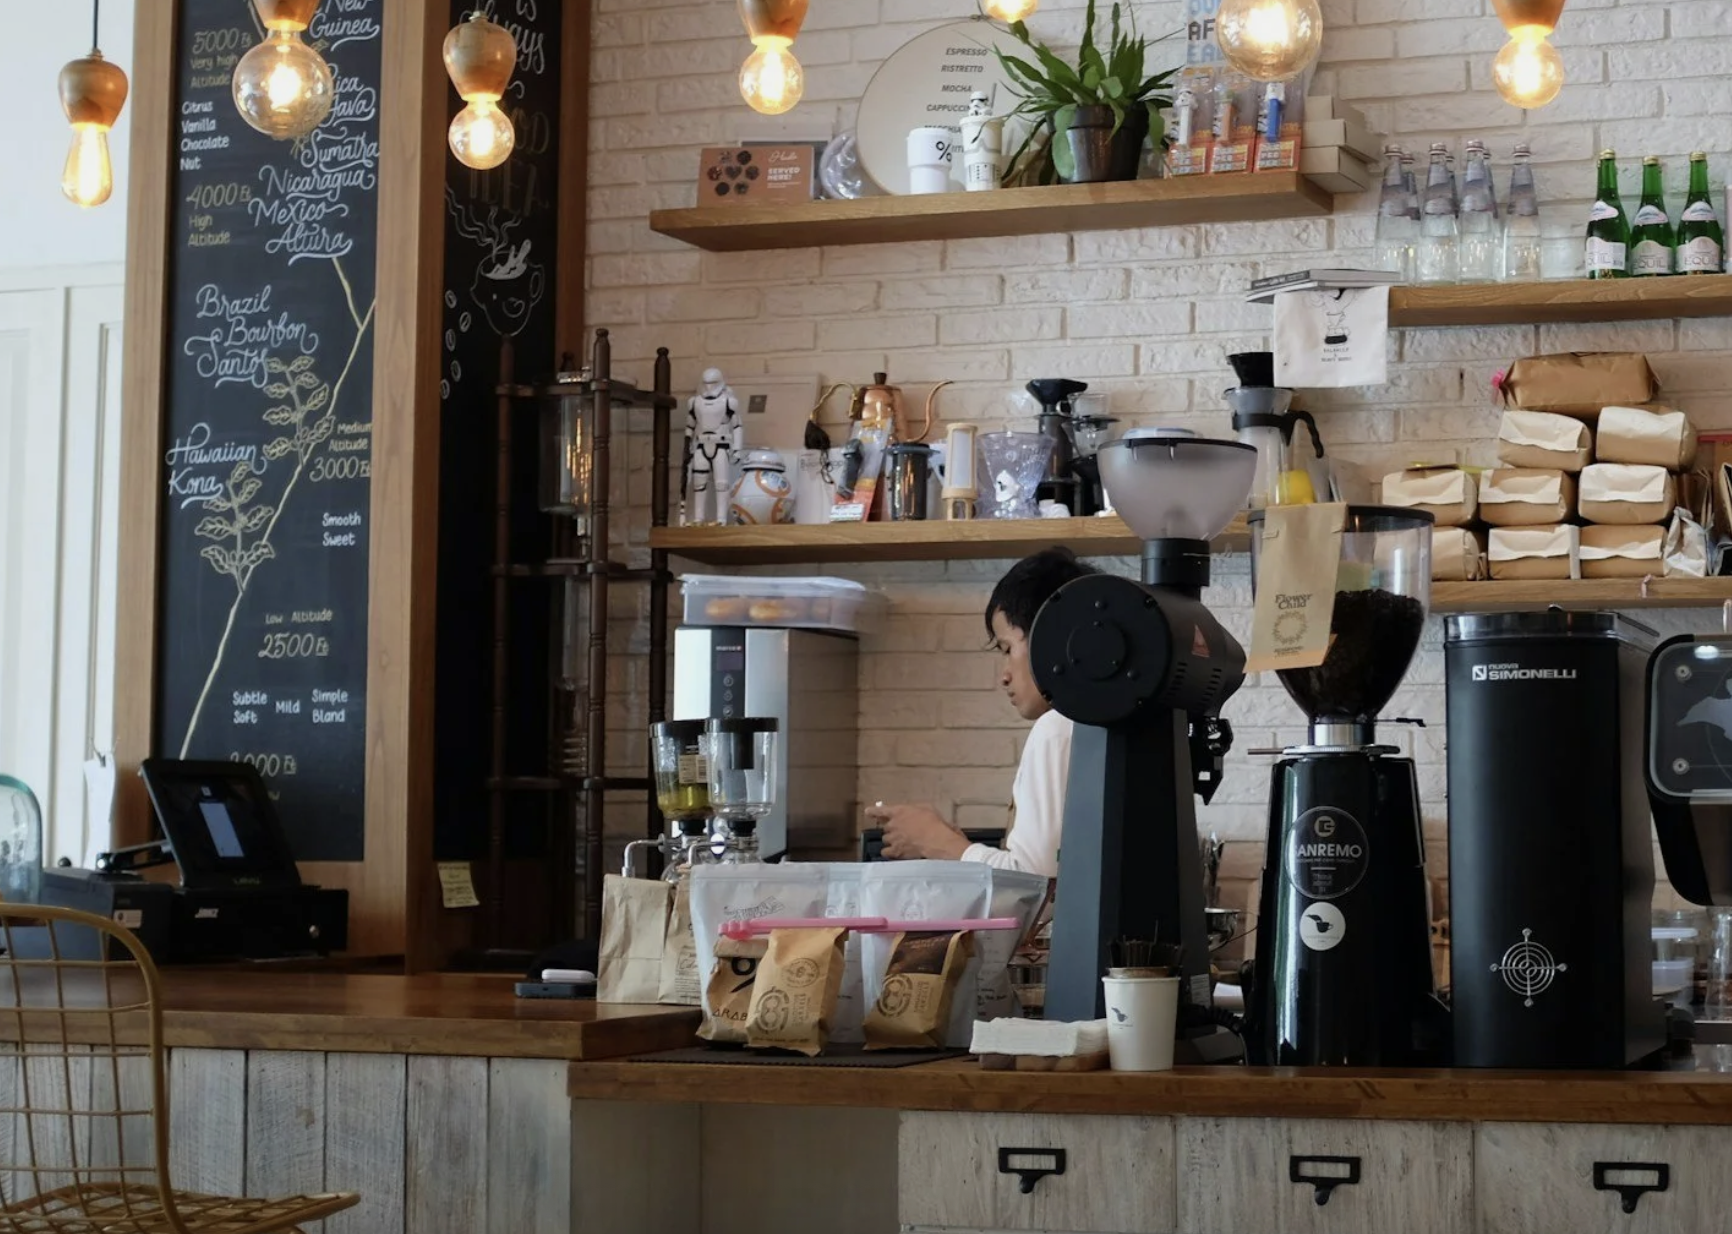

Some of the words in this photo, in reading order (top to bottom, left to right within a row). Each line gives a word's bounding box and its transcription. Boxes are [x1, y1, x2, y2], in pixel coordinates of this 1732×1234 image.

[309, 12, 380, 46] Guinea
[193, 28, 239, 53] 5000
[945, 48, 988, 56] ESPRESSO
[940, 64, 984, 73] RISTRETTO
[190, 74, 232, 88] Altitude
[941, 84, 973, 92] MOCHA
[181, 101, 214, 115] Citrus
[181, 118, 217, 134] Vanilla
[180, 135, 230, 152] Chocolate
[180, 156, 202, 171] Nut
[258, 164, 376, 202] Nicaragua
[186, 182, 238, 210] 4000
[248, 197, 349, 228] Mexico
[188, 214, 213, 231] High
[188, 231, 231, 247] Altitude
[265, 223, 353, 261] Altura
[196, 283, 272, 322] Brazil
[224, 312, 319, 354] Bourbon
[184, 328, 269, 387] Santos
[165, 422, 267, 475] Hawaiian
[328, 438, 368, 452] Altitude
[309, 456, 359, 482] 3000
[168, 467, 224, 504] Kona
[322, 511, 361, 527] Smooth
[322, 532, 356, 547] Sweet
[1274, 593, 1313, 604] Flower
[1277, 600, 1307, 610] Child
[265, 613, 283, 625] Low
[291, 608, 333, 623] Altitude
[258, 633, 315, 659] 2500
[1488, 669, 1577, 681] SIMONELLI
[232, 690, 268, 706] Subtle
[311, 688, 348, 706] Simple
[275, 700, 300, 714] Mild
[233, 710, 258, 725] Soft
[312, 708, 346, 724] Bland
[712, 1008, 749, 1021] ARAB
